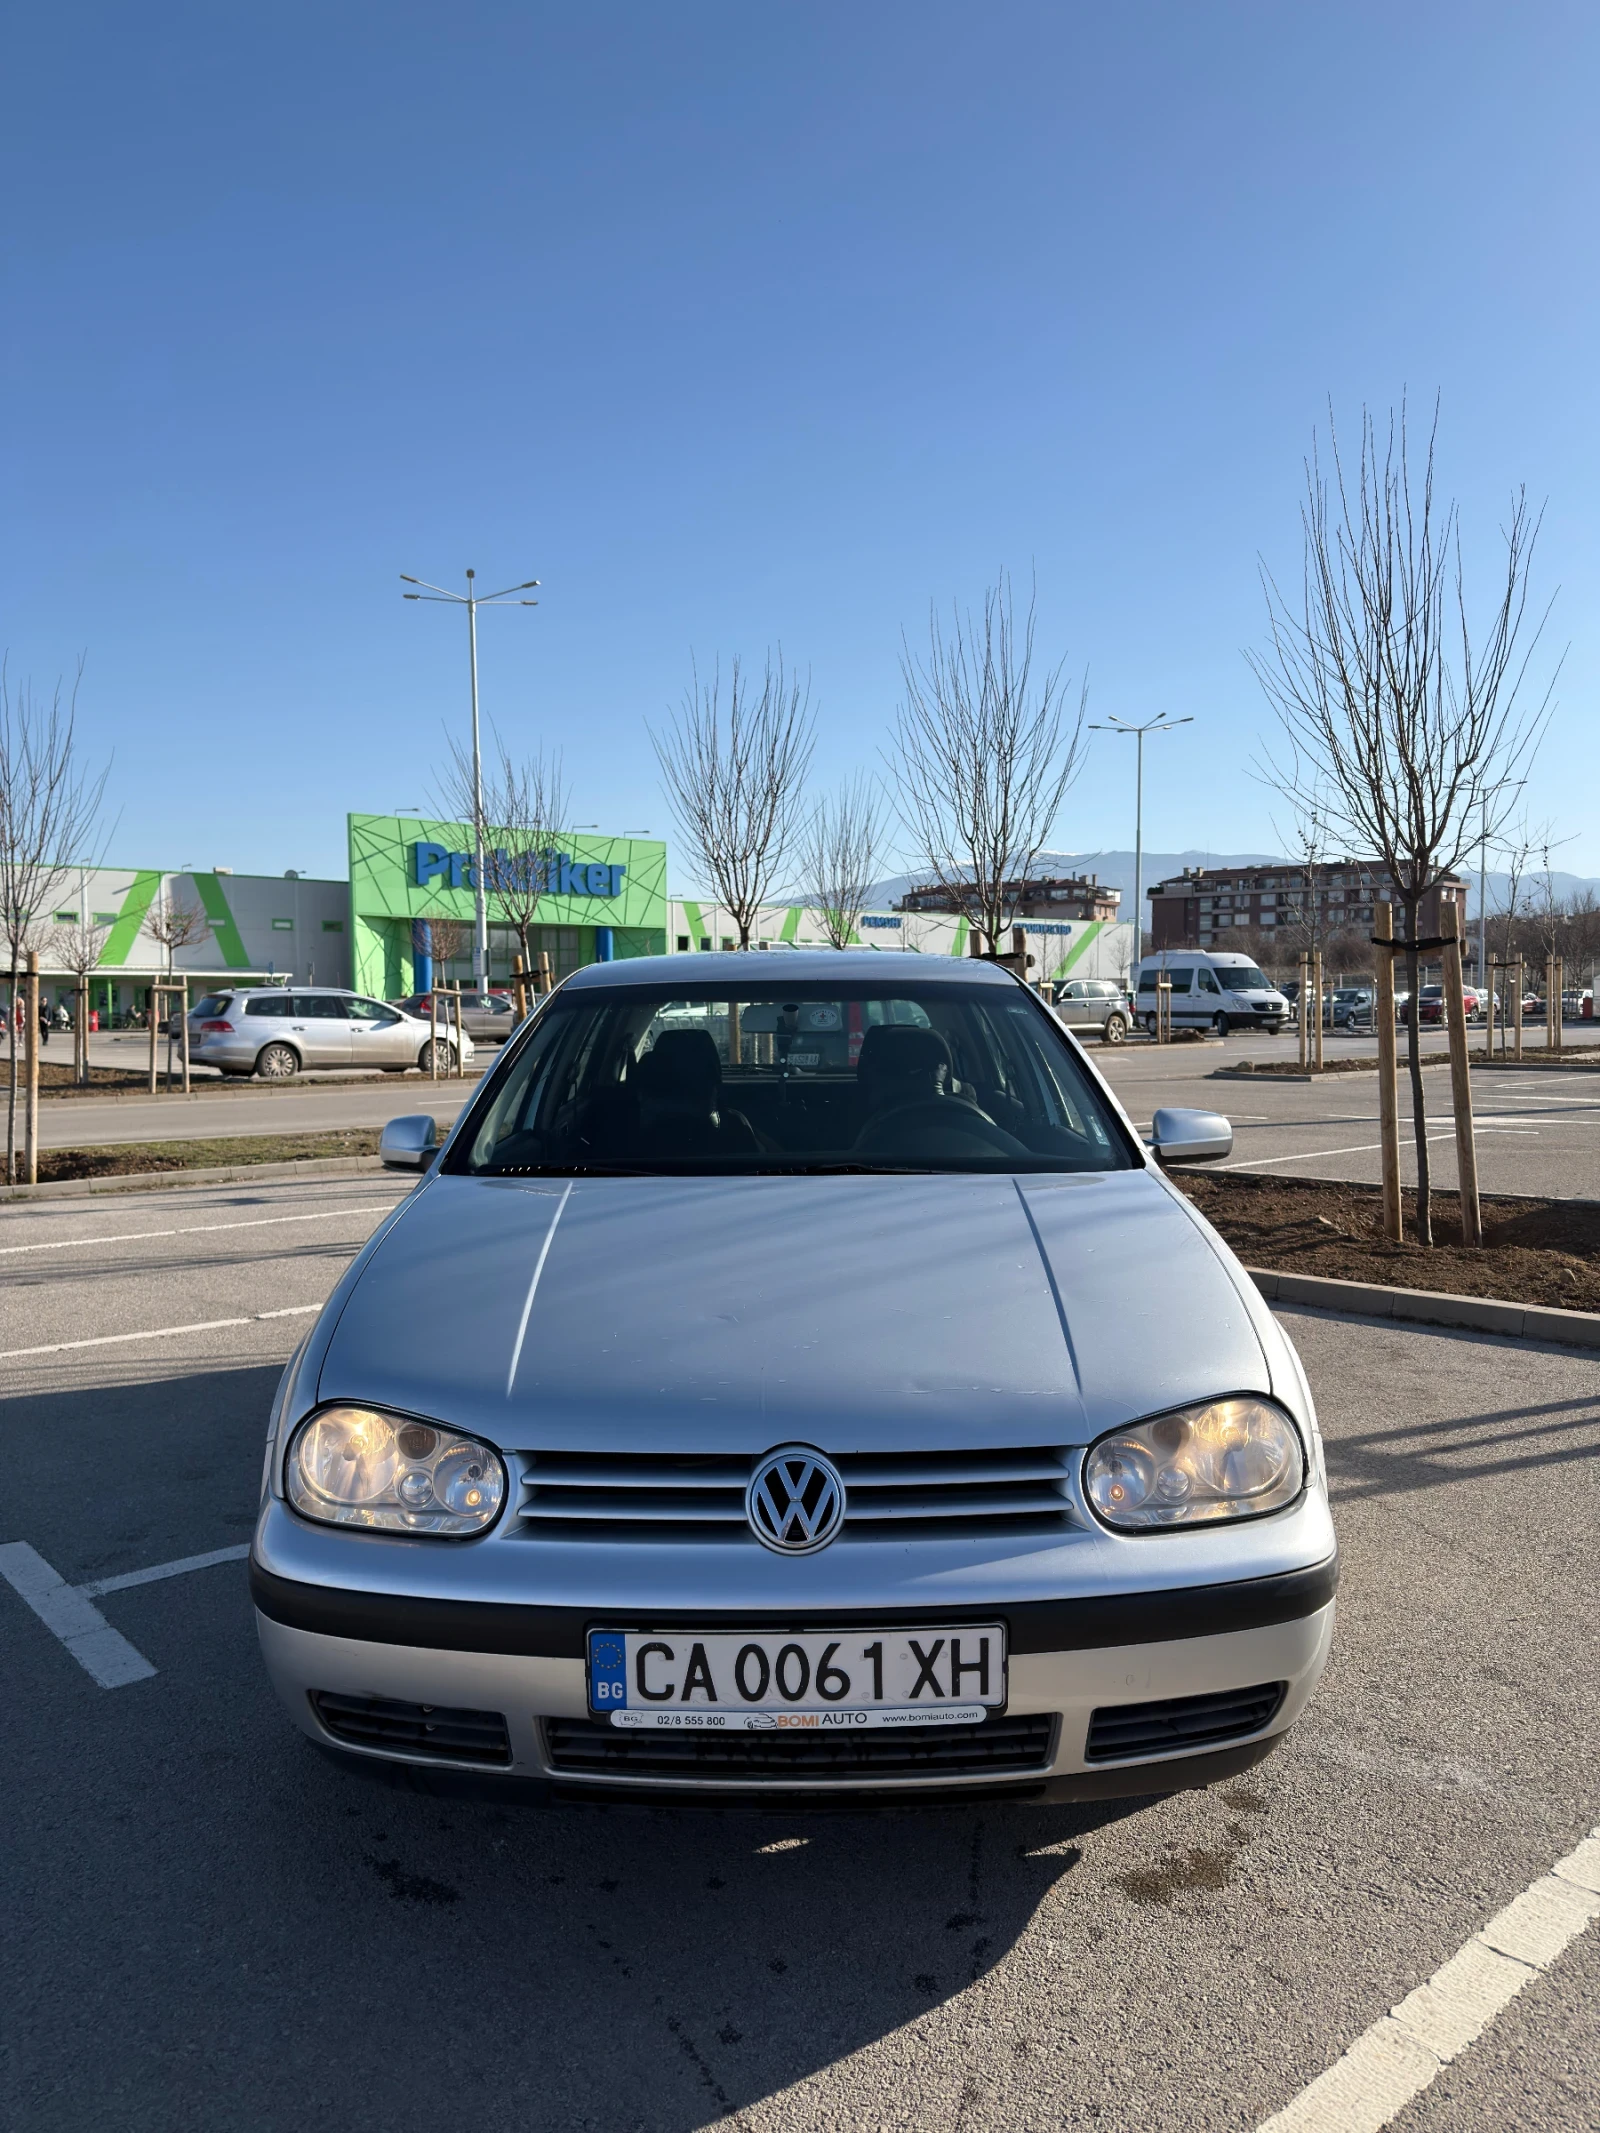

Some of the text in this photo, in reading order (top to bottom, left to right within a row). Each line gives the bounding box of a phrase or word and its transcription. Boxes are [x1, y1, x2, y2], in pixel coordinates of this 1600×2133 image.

[636, 1637, 989, 1702] CA 0061 XH
[598, 1682, 623, 1699] BG
[657, 1715, 682, 1725] 02/8
[685, 1716, 703, 1725] 555
[706, 1716, 726, 1725] 800
[778, 1715, 820, 1728] BOMI
[822, 1712, 868, 1725] AUTO
[882, 1710, 979, 1722] www.bomiauto.com
